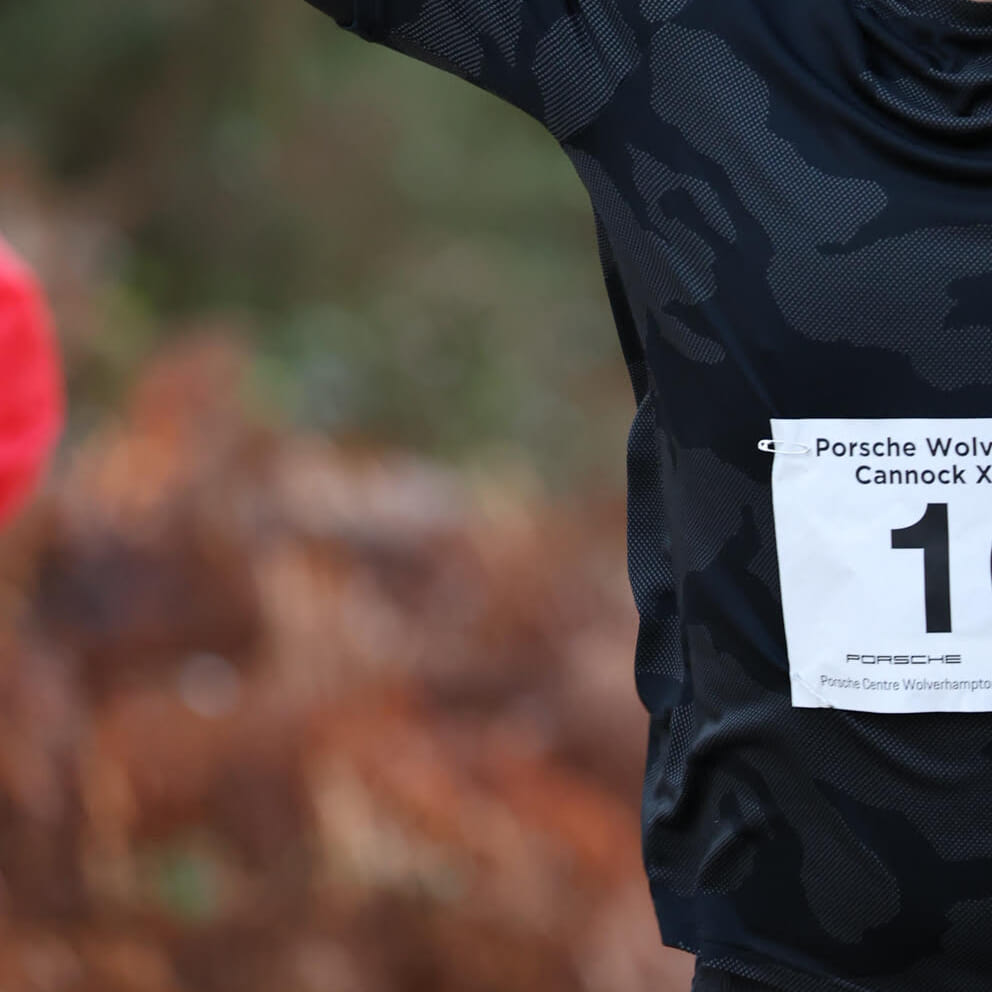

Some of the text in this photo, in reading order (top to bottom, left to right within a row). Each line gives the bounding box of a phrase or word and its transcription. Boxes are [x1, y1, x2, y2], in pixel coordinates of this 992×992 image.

[815, 438, 917, 457] Porsche
[855, 464, 966, 485] Cannock
[846, 654, 962, 665] PORSCHE
[819, 675, 861, 690] Porsche
[862, 677, 900, 691] Centre
